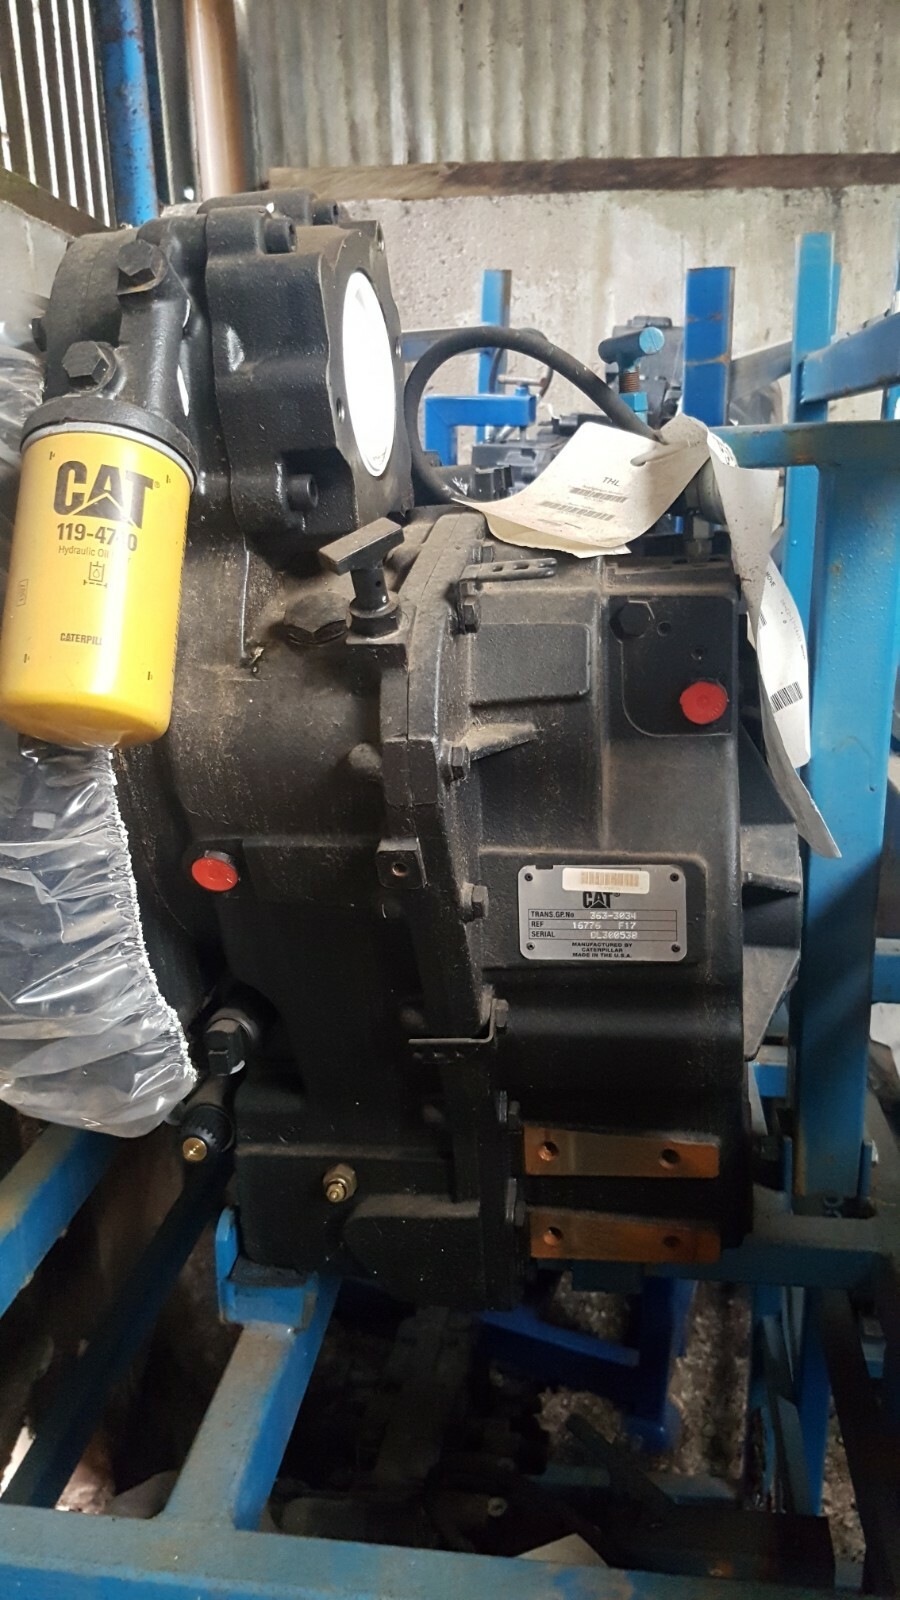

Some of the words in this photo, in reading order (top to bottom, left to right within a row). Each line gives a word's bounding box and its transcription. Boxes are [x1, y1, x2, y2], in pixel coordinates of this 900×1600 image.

[602, 476, 620, 487] THL
[53, 460, 154, 529] CAT
[57, 522, 138, 551] 119-470
[58, 545, 95, 557] Hydraulic
[98, 548, 109, 558] Oil
[60, 632, 103, 646] CATERPILL
[582, 891, 613, 909] CAT
[589, 911, 637, 920] 363-3034
[572, 921, 601, 930] 16776
[618, 922, 637, 930] F17
